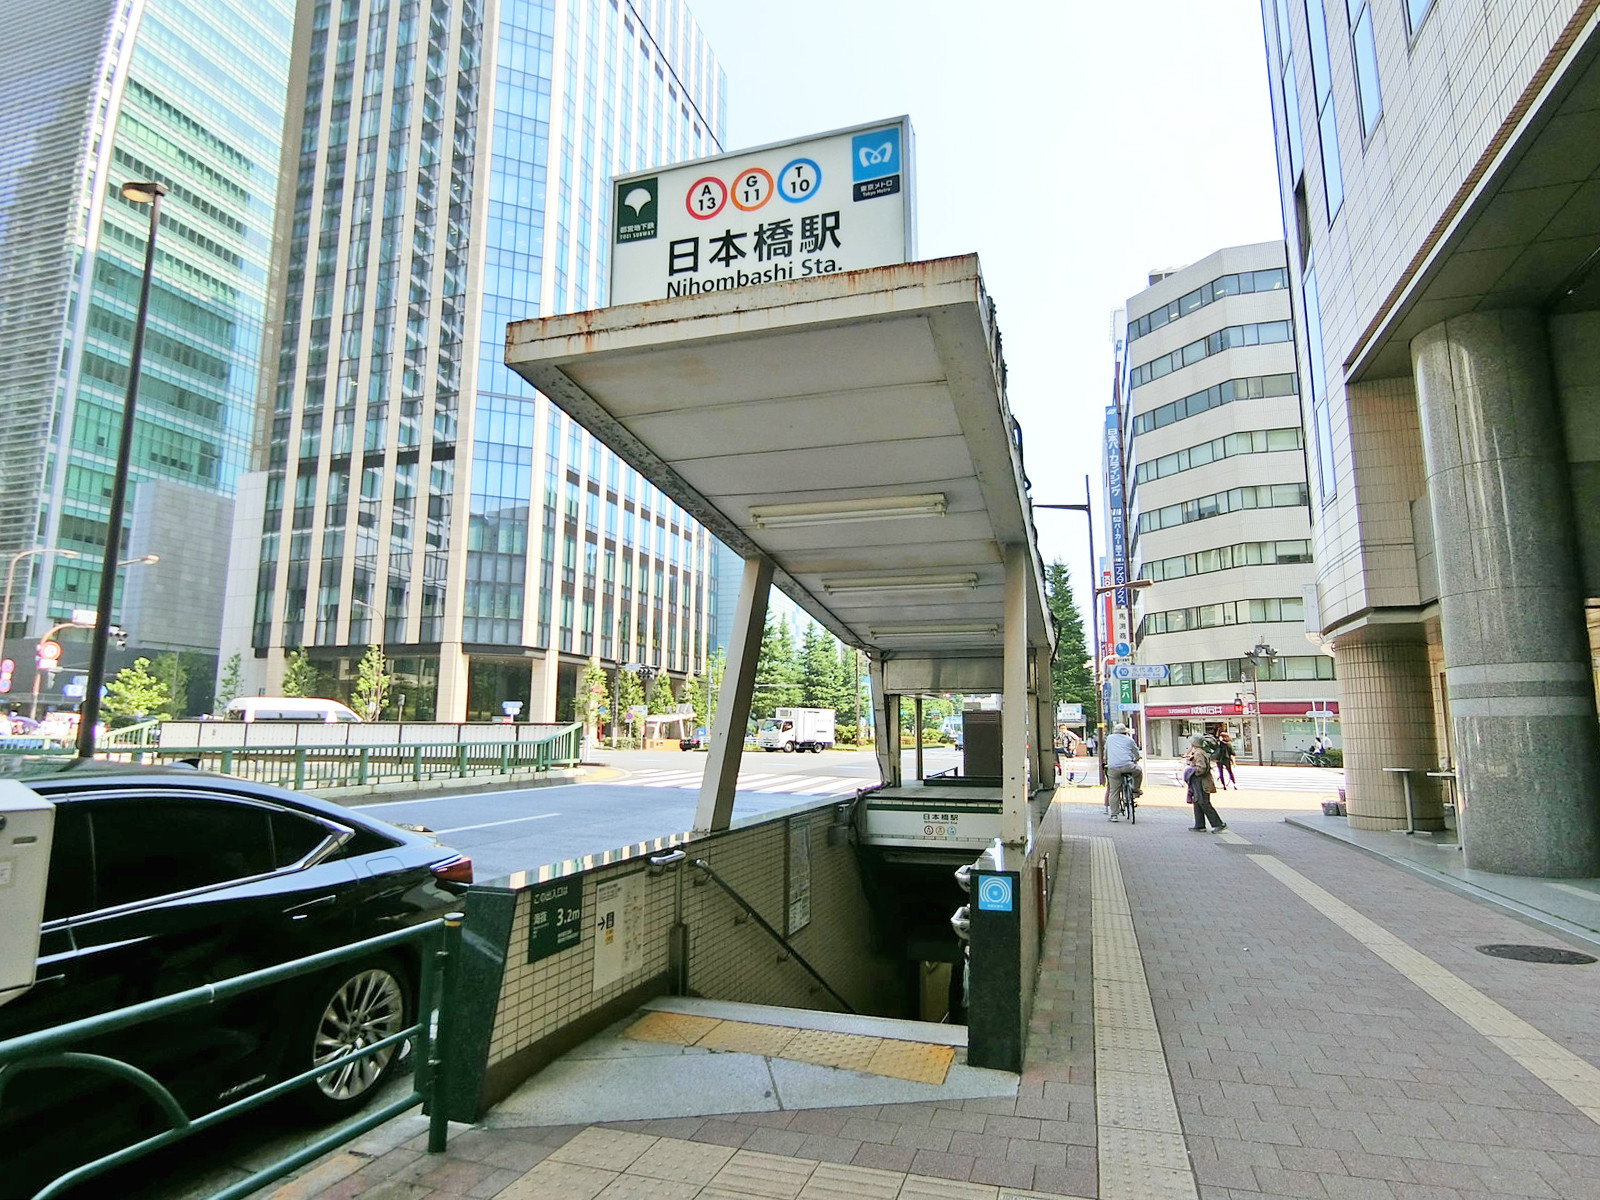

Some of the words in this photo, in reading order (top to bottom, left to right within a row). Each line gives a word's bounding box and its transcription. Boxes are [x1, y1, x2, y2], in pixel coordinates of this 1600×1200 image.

[795, 166, 803, 178] T
[746, 175, 758, 187] G
[790, 179, 810, 194] 10
[860, 180, 893, 192] 東京メトロ
[701, 184, 712, 197] A
[743, 188, 760, 203] 11
[698, 197, 716, 211] 13
[620, 221, 655, 233] 都営地下鉄
[668, 210, 842, 277] 日本橋駅
[667, 261, 793, 299] Nihombashi
[801, 257, 843, 277] Sta.
[923, 813, 959, 821] 日本橋駅
[556, 907, 580, 927] 3.2m
